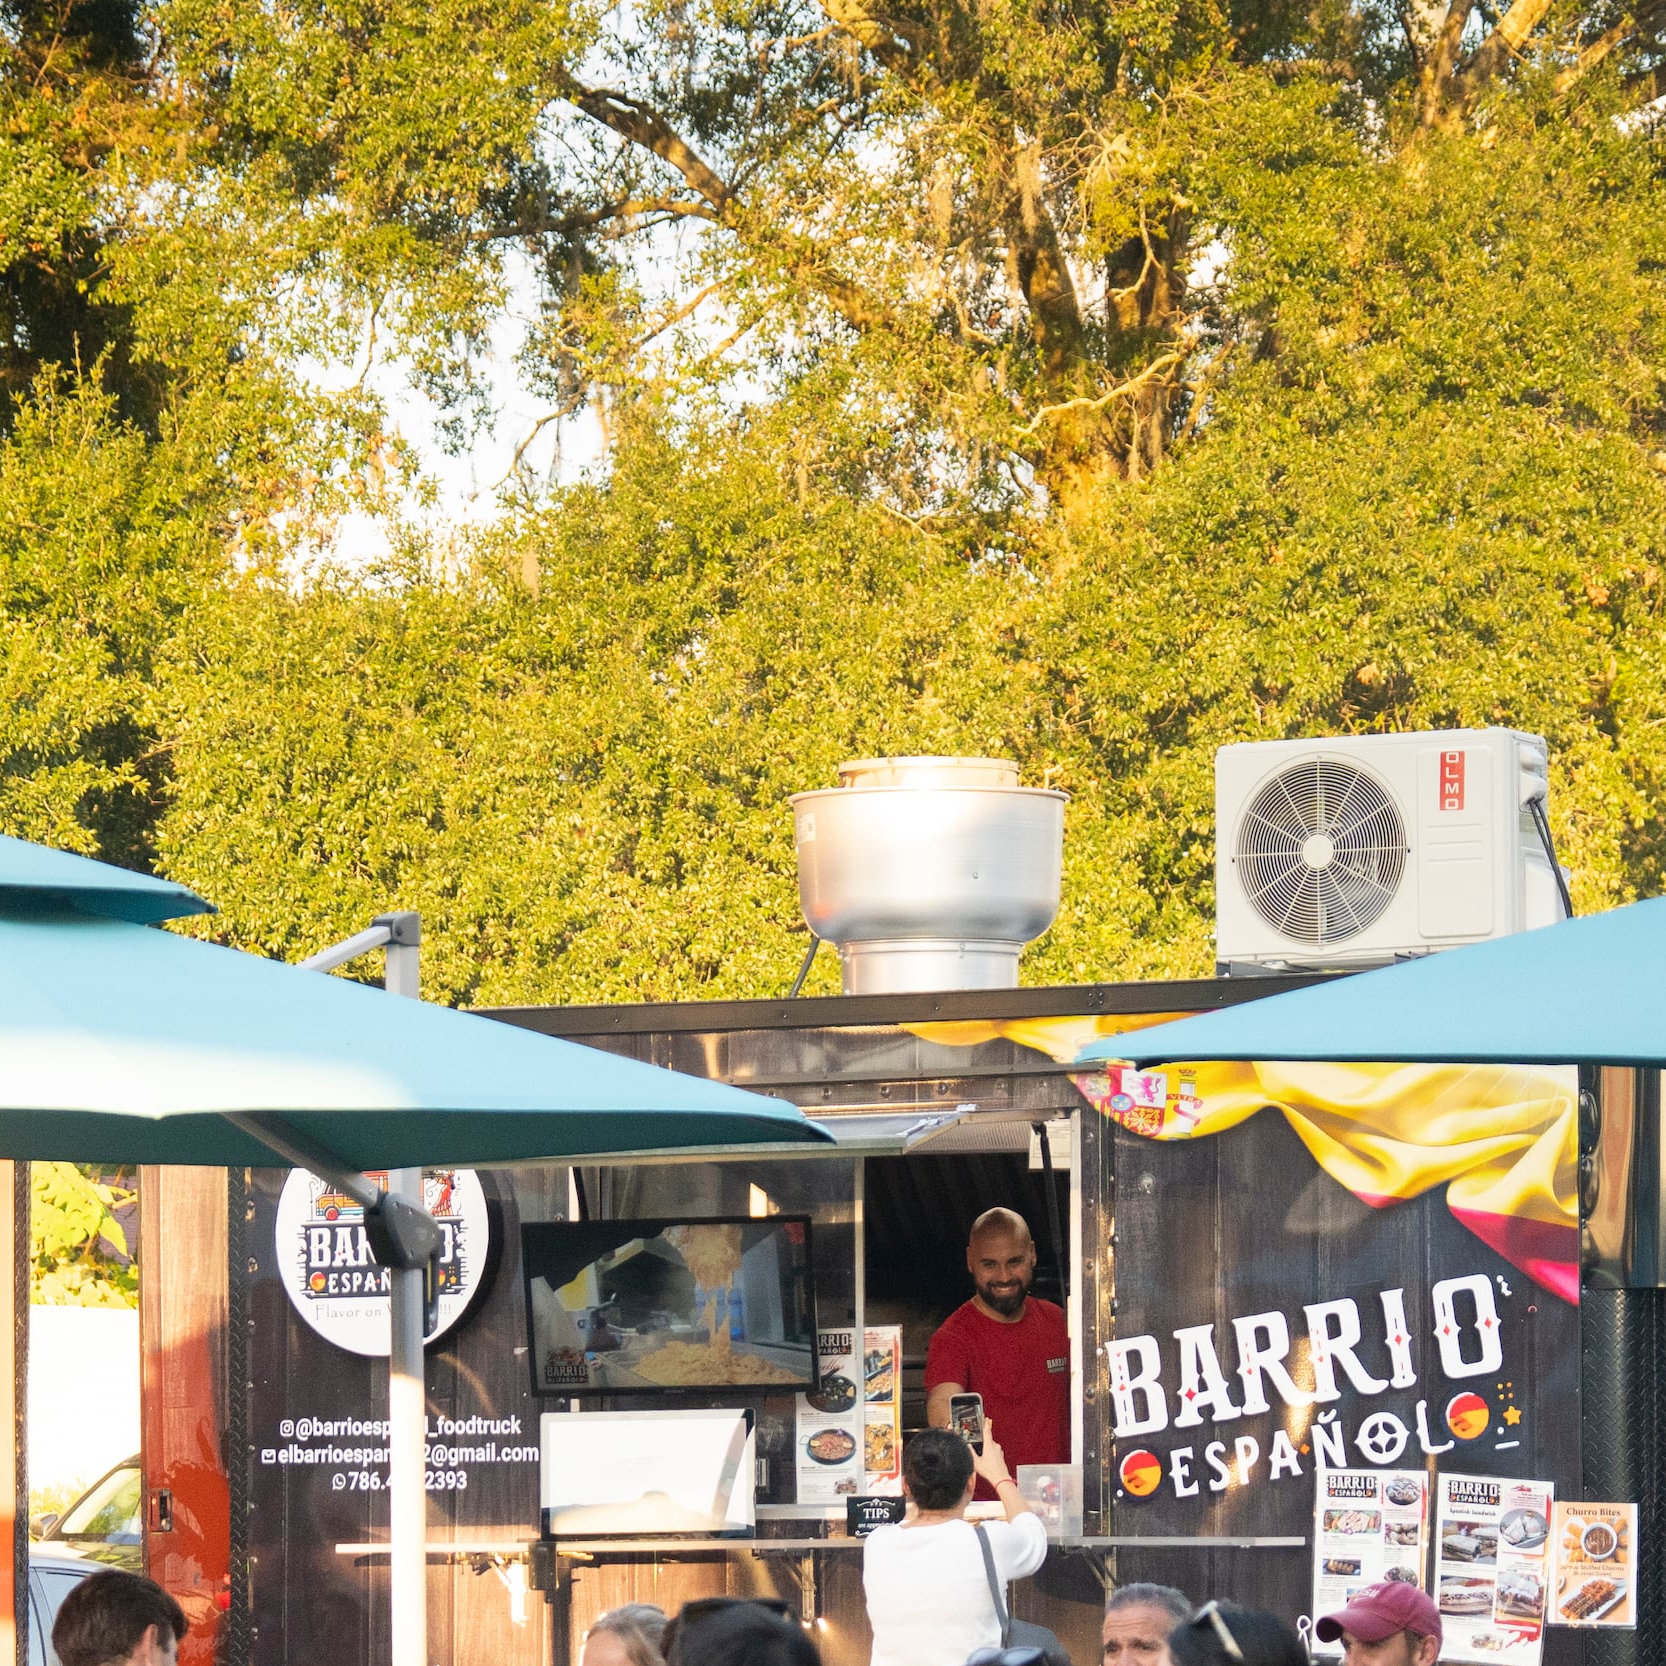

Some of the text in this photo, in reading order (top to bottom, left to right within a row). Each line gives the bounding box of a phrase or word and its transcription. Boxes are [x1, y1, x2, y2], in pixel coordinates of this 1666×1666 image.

[1445, 752, 1459, 810] OLMO
[315, 1304, 360, 1320] Flavor
[365, 1306, 381, 1316] on
[1104, 1273, 1502, 1438] BARRIO
[1169, 1400, 1455, 1497] ESPAÑOL
[1329, 1476, 1374, 1489] BARRIO
[1451, 1481, 1498, 1497] BARRIO
[1335, 1488, 1367, 1497] ESPAÑOL
[1456, 1493, 1490, 1504] ESPAÑOL
[863, 1508, 890, 1519] TIPS
[1566, 1507, 1621, 1516] Churro Bites
